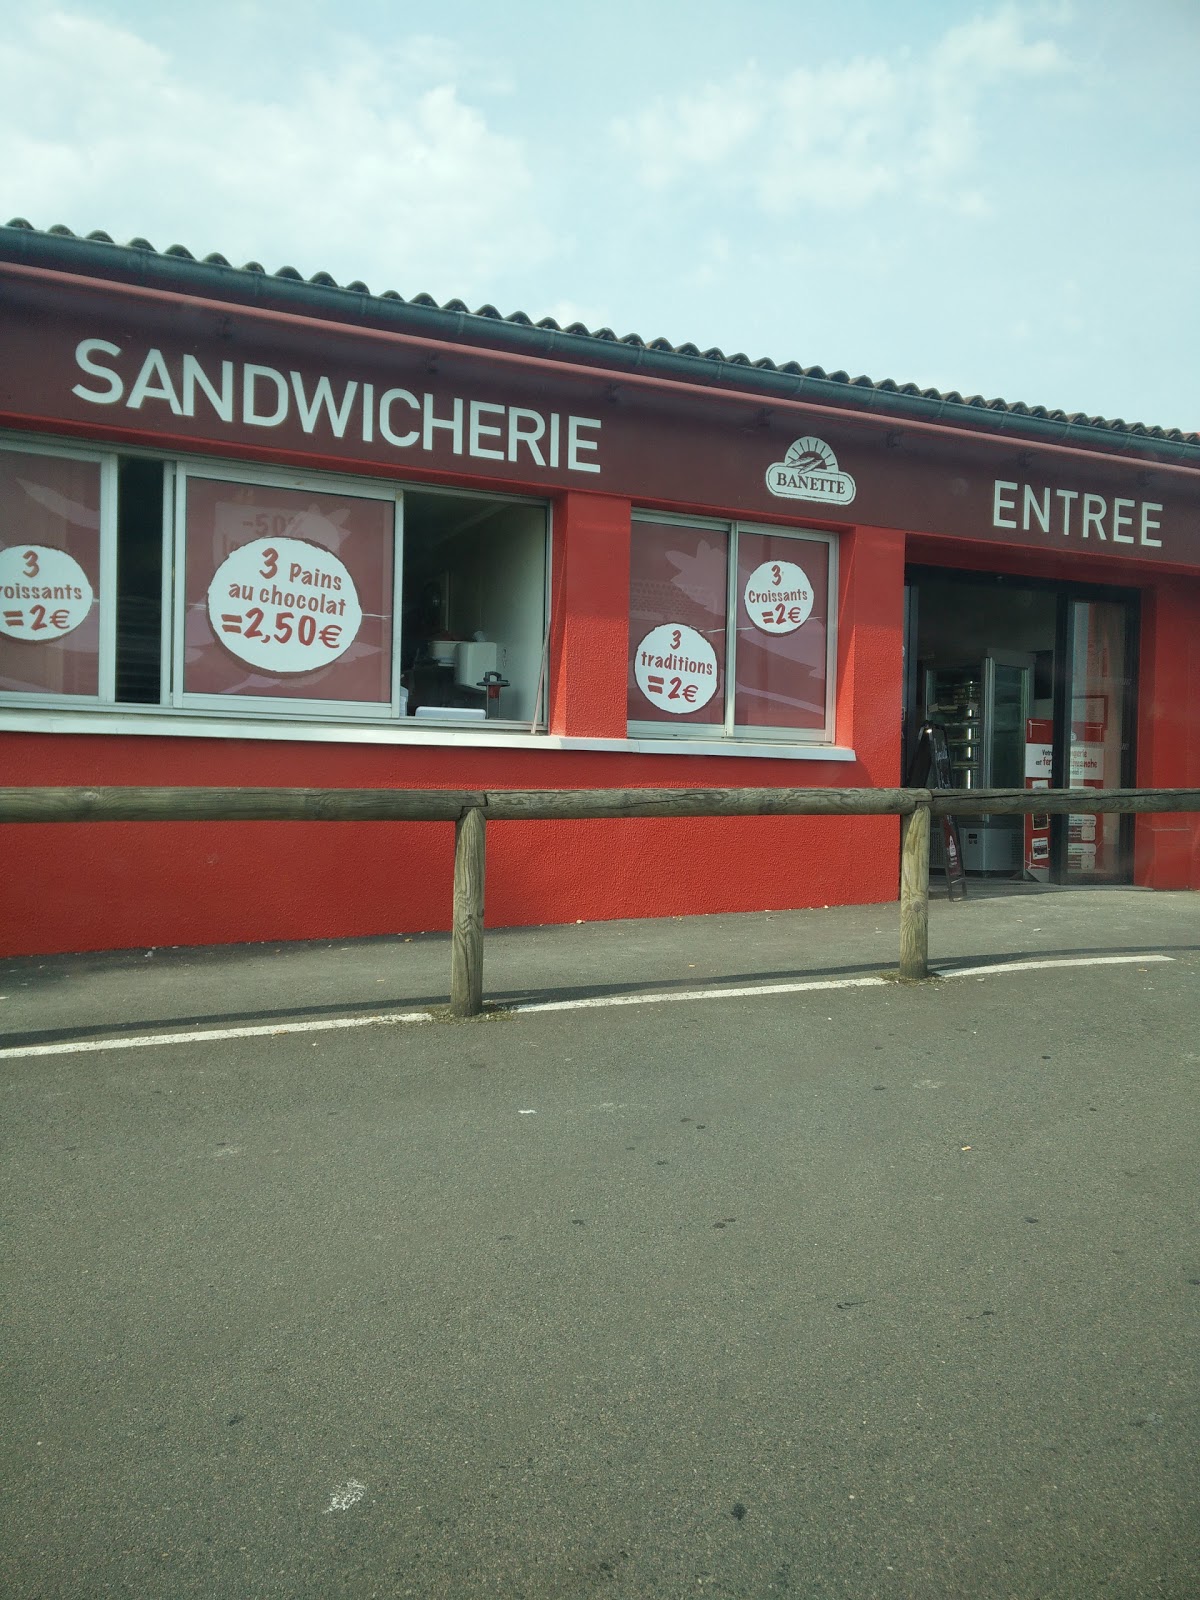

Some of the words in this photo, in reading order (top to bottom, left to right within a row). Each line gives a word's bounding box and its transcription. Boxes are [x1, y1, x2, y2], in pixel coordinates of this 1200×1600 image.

[71, 338, 602, 474] SANDWICHERIE
[776, 472, 846, 494] BANETTE
[992, 479, 1164, 548] ENTREE
[22, 550, 40, 578] 3
[258, 547, 279, 579] 3
[771, 564, 782, 586] 3
[228, 583, 253, 601] au
[259, 585, 346, 616] chocolat
[748, 588, 808, 603] Croissants
[669, 630, 682, 650] 3
[641, 651, 713, 676] traditions
